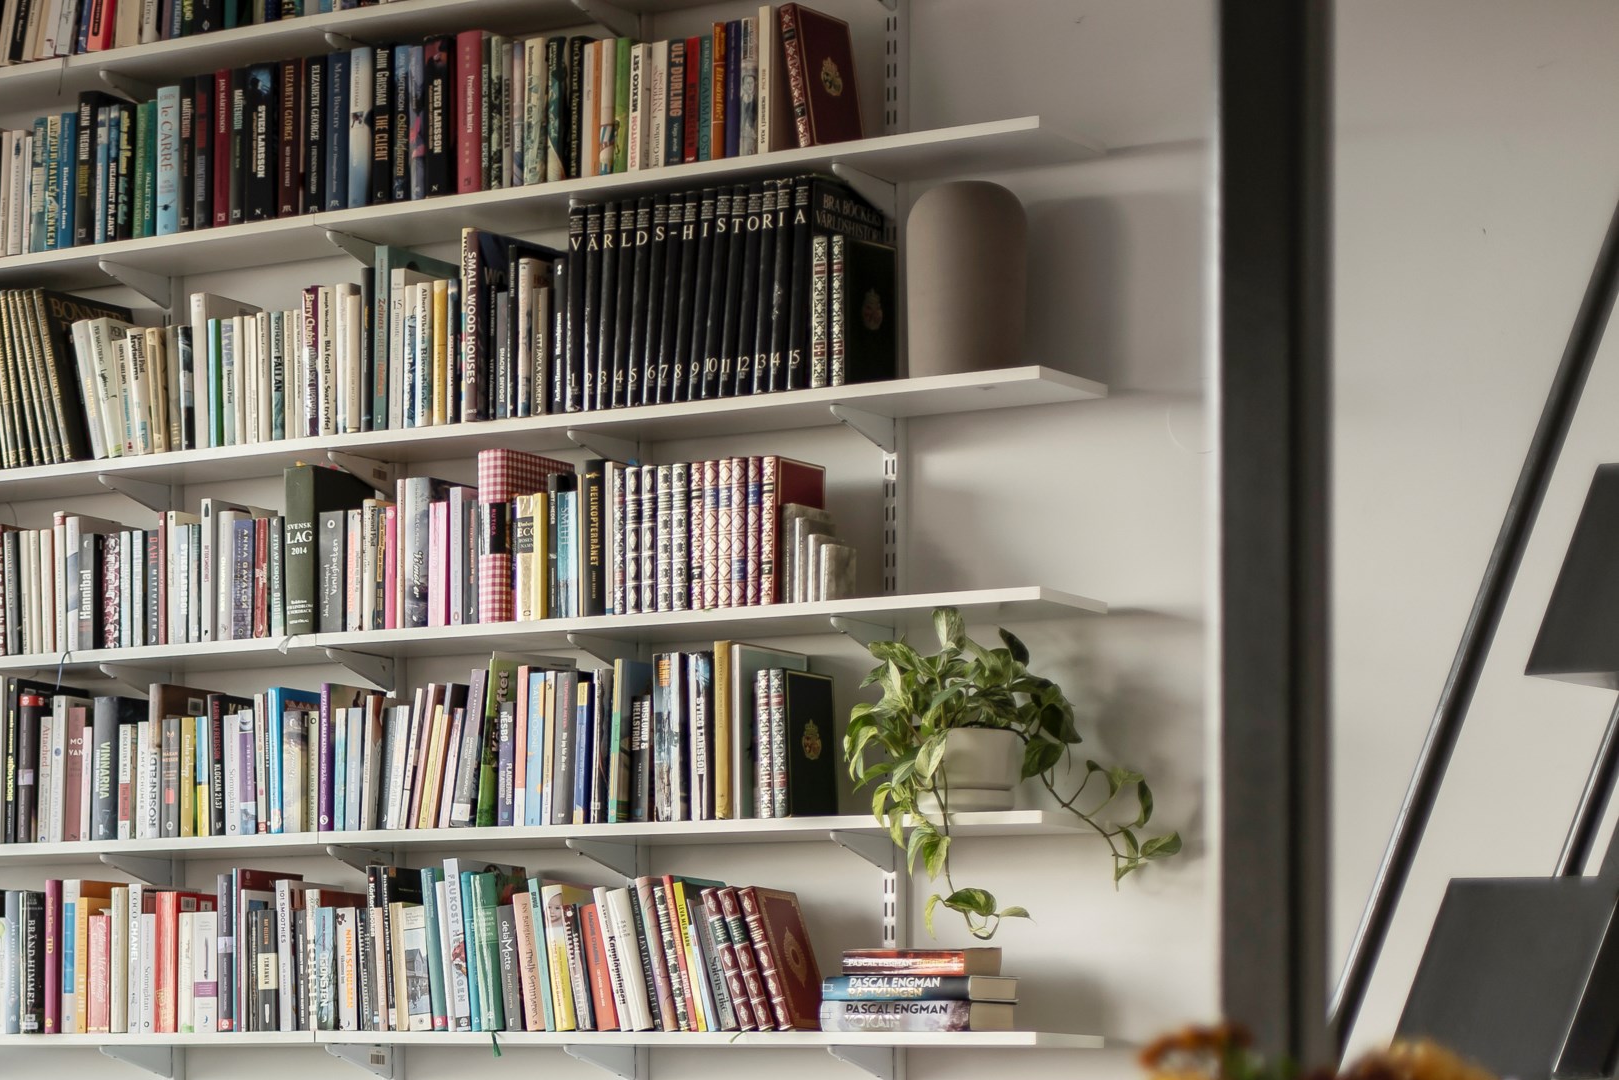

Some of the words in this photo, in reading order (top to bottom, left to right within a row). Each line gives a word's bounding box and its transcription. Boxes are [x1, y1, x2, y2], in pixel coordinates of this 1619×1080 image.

[376, 48, 389, 68] JOHN
[633, 54, 641, 72] SET
[671, 43, 684, 64] ULF
[284, 64, 294, 107] ELIZABETH
[311, 64, 321, 106] ELIZABETH
[333, 62, 342, 93] MAEVE
[376, 70, 389, 105] GRISHAM
[669, 65, 684, 117] DURLING
[433, 78, 442, 108] STIEG
[632, 74, 640, 113] MEXICO
[701, 76, 709, 130] GAMMAL
[80, 102, 90, 126] JOHAN
[161, 105, 173, 117] le
[219, 92, 227, 134] MÅRTENSON
[257, 104, 266, 133] STIEG
[284, 109, 294, 141] GEORGE
[310, 108, 319, 141] GEORGE
[332, 95, 341, 128] BINCHY
[375, 114, 388, 131] THE
[79, 130, 90, 160] THEORIN
[433, 109, 441, 154] LARSSON
[631, 116, 639, 168] DEIGHTON
[160, 120, 174, 172] CARRÉ
[256, 134, 265, 178] LARSSON
[375, 133, 388, 161] CLIENT
[700, 134, 709, 160] OST
[466, 251, 476, 291] SMALL
[304, 294, 315, 317] Barry
[377, 297, 386, 330] Zeinas
[393, 299, 403, 310] 15
[466, 294, 476, 333] WOOD
[305, 318, 315, 345] Chubin
[535, 333, 543, 347] ETT
[324, 340, 332, 352] Blå
[535, 348, 543, 372] JÄVLA
[770, 351, 780, 367] 14
[789, 350, 800, 365] 15
[466, 336, 476, 385] HOUSES
[647, 364, 656, 379] 6
[660, 364, 668, 379] 7
[675, 363, 682, 378] 8
[691, 362, 699, 378] 9
[705, 357, 718, 373] 10
[721, 356, 731, 373] 11
[737, 356, 750, 371] 12
[754, 354, 766, 369] 13
[535, 373, 543, 404] SOLSKEN
[570, 372, 576, 387] 1
[587, 373, 593, 387] 2
[599, 371, 607, 385] 3
[615, 370, 623, 384] 4
[630, 368, 637, 383] 5
[323, 406, 331, 430] tryffel
[286, 522, 312, 531] SVENSK
[286, 530, 313, 545] LAG
[560, 507, 569, 545] SMITH
[589, 485, 601, 567] HELIKOPTERRÅNET
[149, 536, 158, 566] DAHL
[273, 551, 280, 562] AV
[291, 546, 308, 556] 2014
[412, 550, 423, 563] Vi
[413, 564, 421, 583] mot
[80, 569, 91, 619] Hannibal
[180, 572, 188, 615] LARSSON
[413, 585, 420, 598] er
[500, 711, 509, 742] NESBØ
[531, 713, 539, 754] ROONEY
[631, 701, 642, 750] HELLSTRÖM
[641, 700, 649, 740] ROSLUND
[41, 725, 51, 767] Attached
[184, 734, 192, 755] Emelie
[213, 721, 221, 760] ALFREDSSON
[99, 741, 111, 800] VINNARNA
[181, 756, 191, 777] Schepp
[214, 763, 222, 792] KLOCKAN
[148, 751, 158, 829] ROSENFELDT
[227, 768, 237, 814] Sömngåtan
[448, 873, 460, 924] FRUKOST
[27, 919, 37, 956] BRÄND
[46, 936, 54, 954] TID
[97, 921, 106, 953] Colleen
[131, 920, 139, 963] CHANEL
[345, 928, 353, 957] NINNI
[572, 932, 580, 954] SOFIE
[638, 935, 647, 951] LEV
[683, 932, 691, 948] BARN
[641, 952, 652, 973] LIVET
[27, 959, 36, 1006] HIMMEL
[97, 955, 106, 1002] McCullough
[143, 965, 151, 1011] Sömngåtan
[708, 956, 723, 991] Solens
[717, 992, 729, 1014] rike
[849, 977, 890, 988] PASCAL
[891, 977, 941, 988] ENGMAN
[844, 1014, 901, 1029] KOKAIN
[846, 1003, 892, 1015] PASCAL
[893, 1003, 949, 1015] ENGMAN
